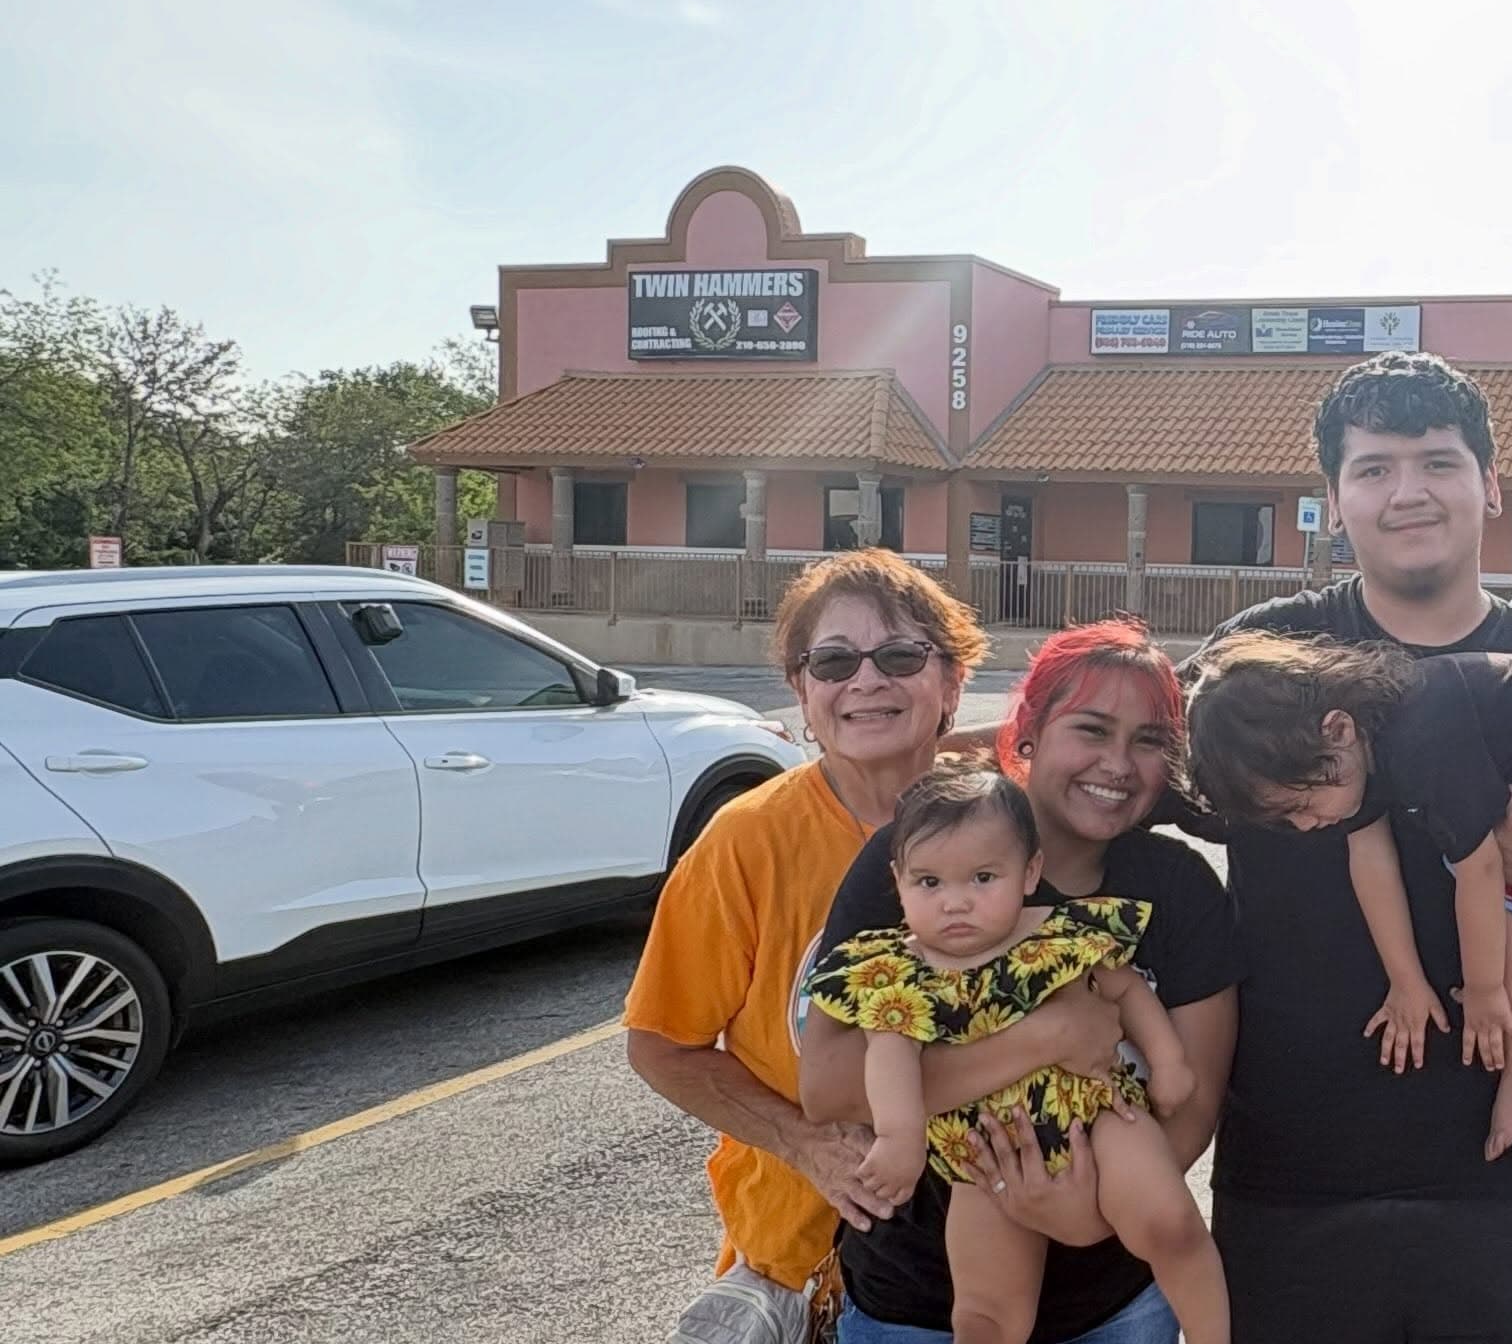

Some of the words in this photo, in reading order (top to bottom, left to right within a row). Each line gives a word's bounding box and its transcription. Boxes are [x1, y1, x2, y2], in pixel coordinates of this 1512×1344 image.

[632, 273, 689, 298] TWIN
[693, 272, 804, 297] HAMMERS
[632, 337, 692, 350] CONTRACTING
[1206, 330, 1237, 339] AUTO
[951, 323, 968, 411] 9258
